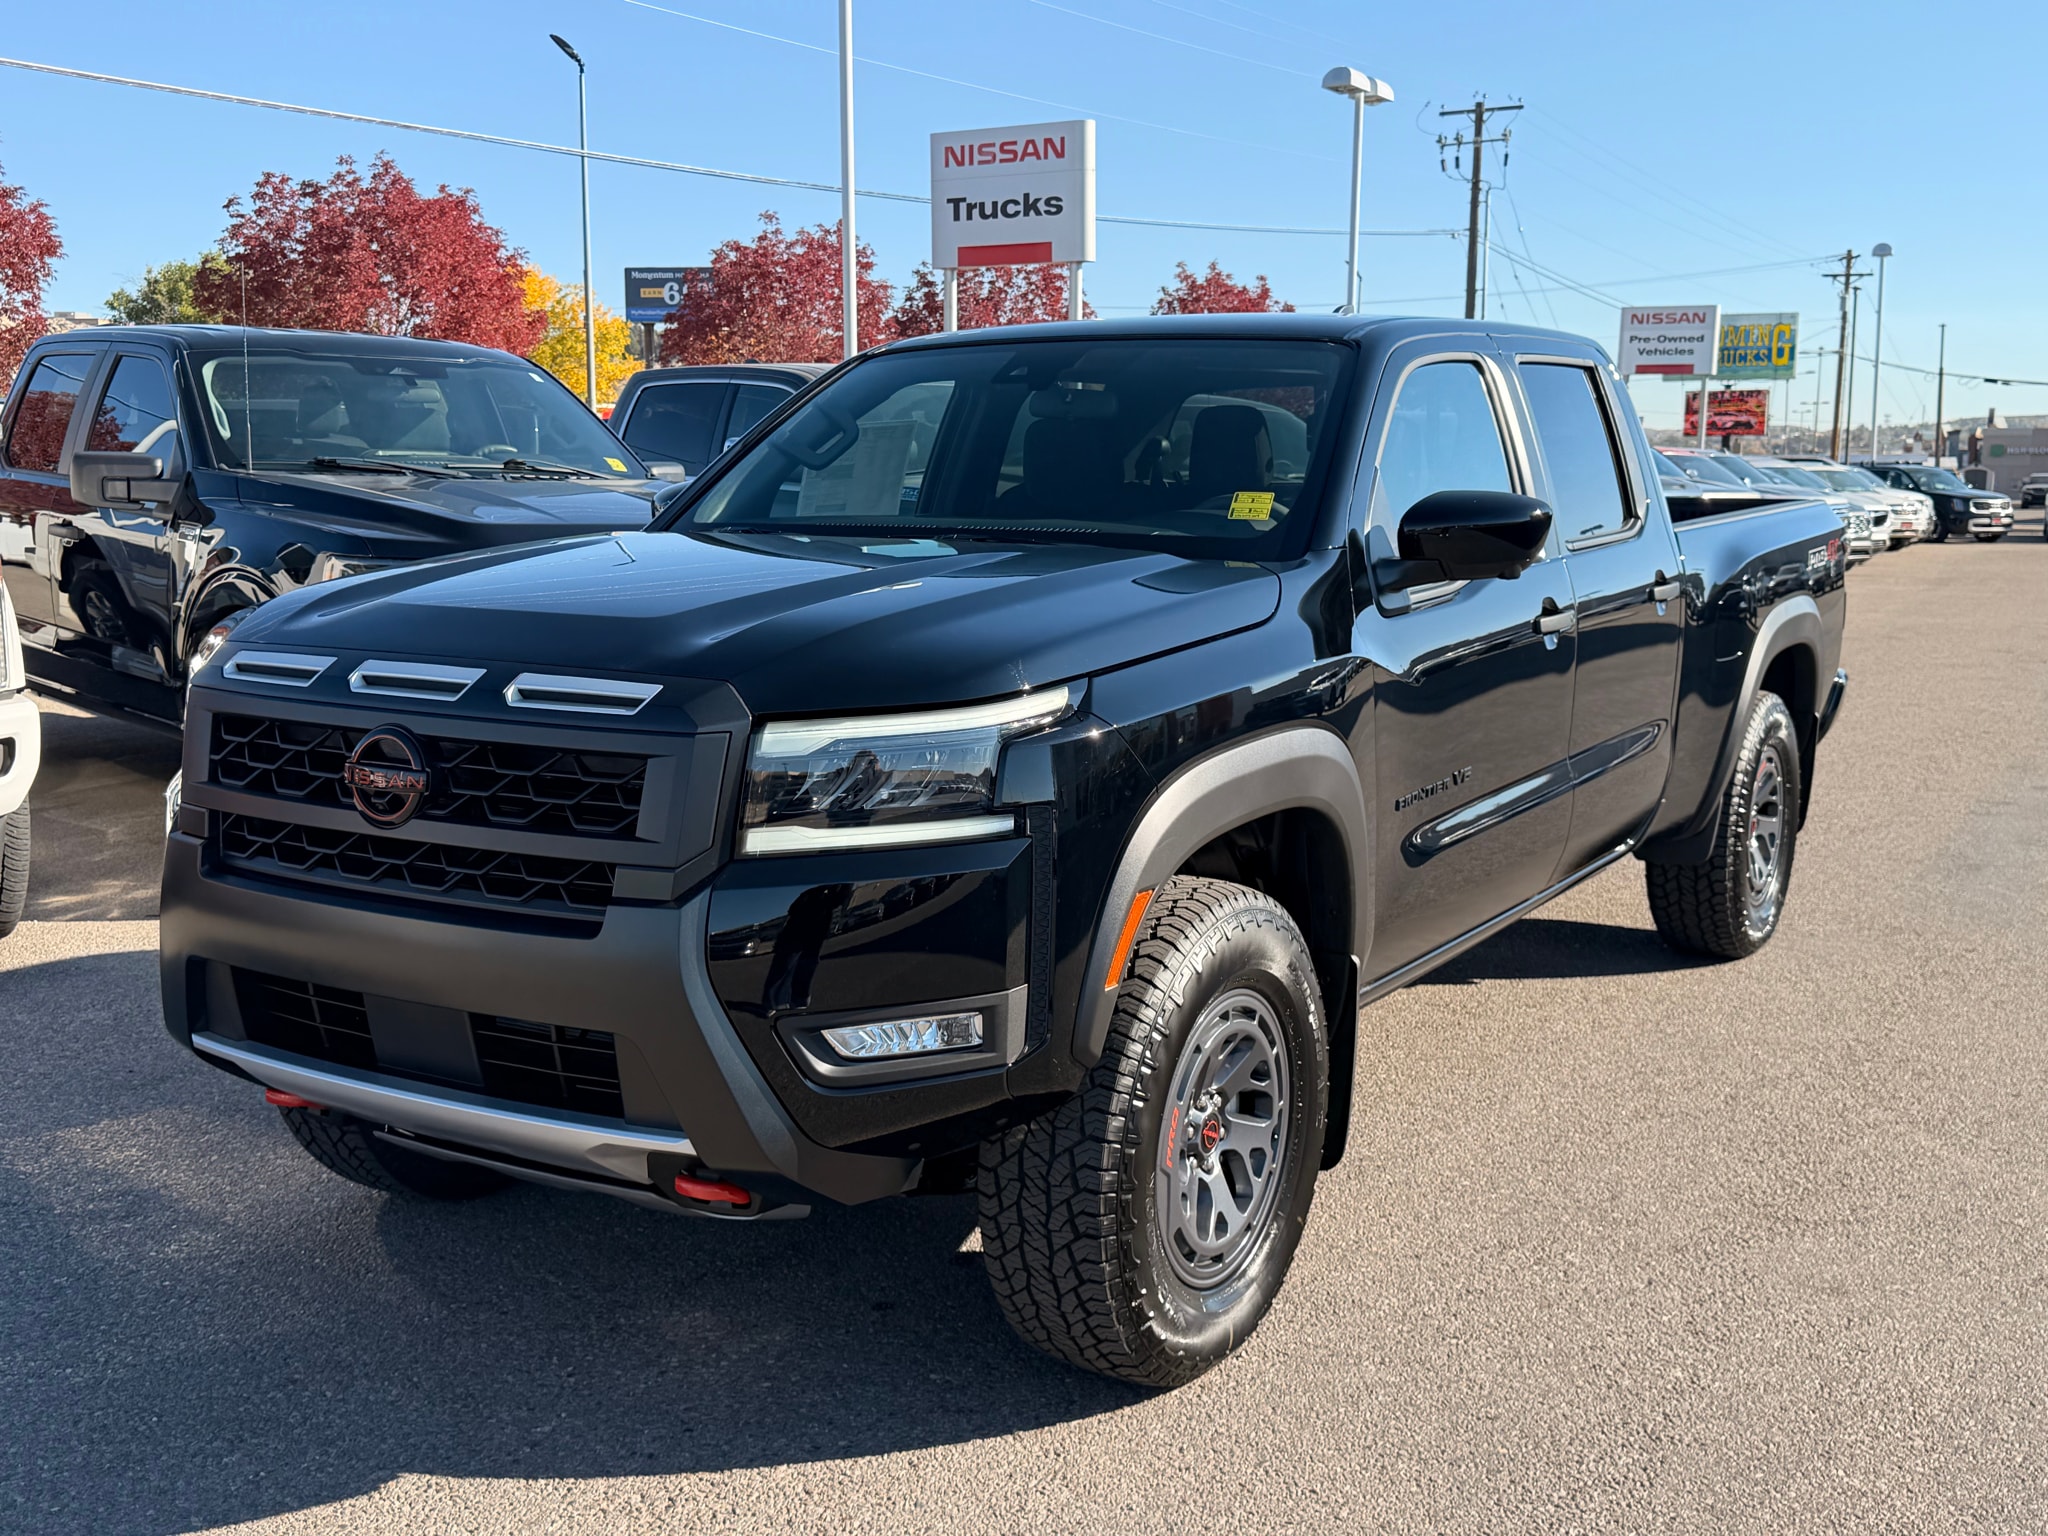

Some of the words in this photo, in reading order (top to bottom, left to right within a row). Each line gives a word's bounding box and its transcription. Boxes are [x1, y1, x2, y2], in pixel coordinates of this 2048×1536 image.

[944, 136, 1066, 168] NISSAN
[946, 193, 1064, 222] Trucks
[631, 271, 674, 280] Momentum
[1630, 312, 1706, 325] NISSAN
[1629, 334, 1705, 344] Pre-Owned
[1637, 347, 1695, 356] Vehicles
[344, 766, 424, 790] NISSAN
[1394, 778, 1450, 812] FRONTIER
